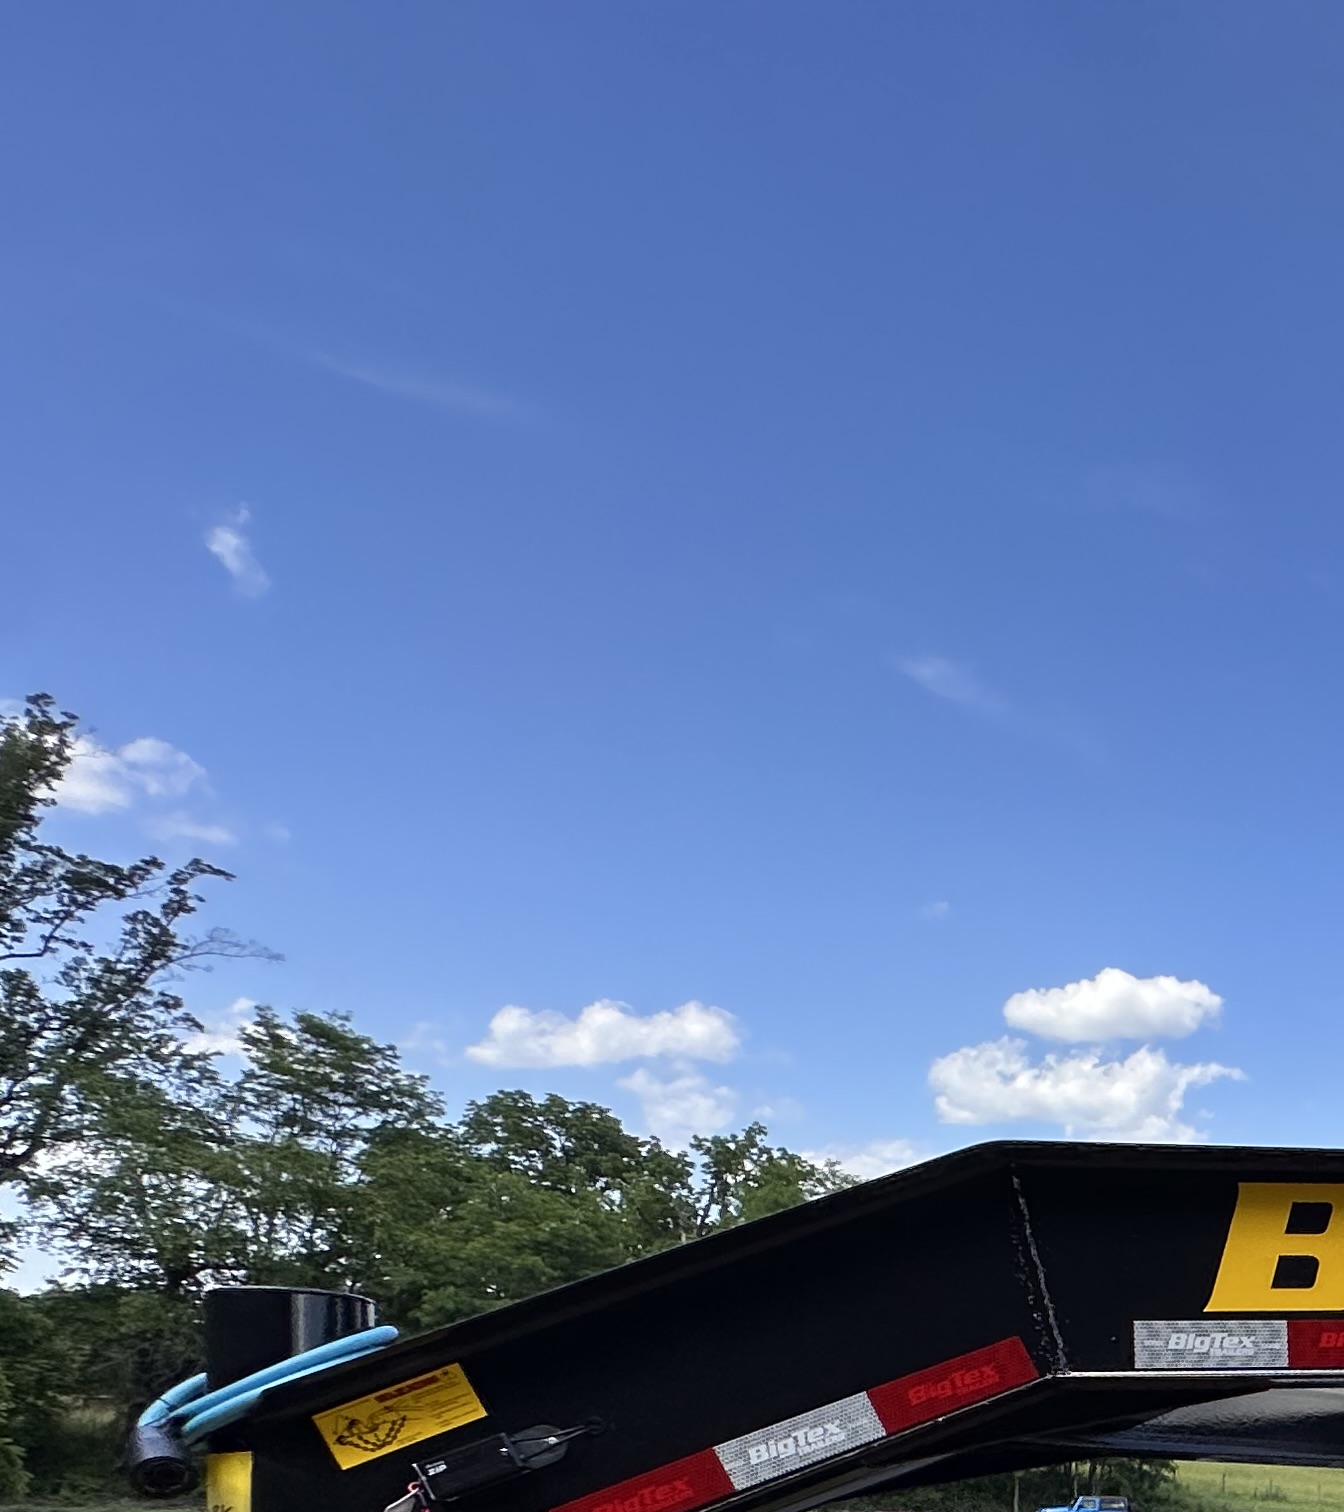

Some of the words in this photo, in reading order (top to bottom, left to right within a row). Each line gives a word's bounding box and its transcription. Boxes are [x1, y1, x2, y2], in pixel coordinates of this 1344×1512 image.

[1168, 1332, 1256, 1352] BigTex
[907, 1364, 997, 1406] BigTex
[749, 1419, 843, 1464] BigTex
